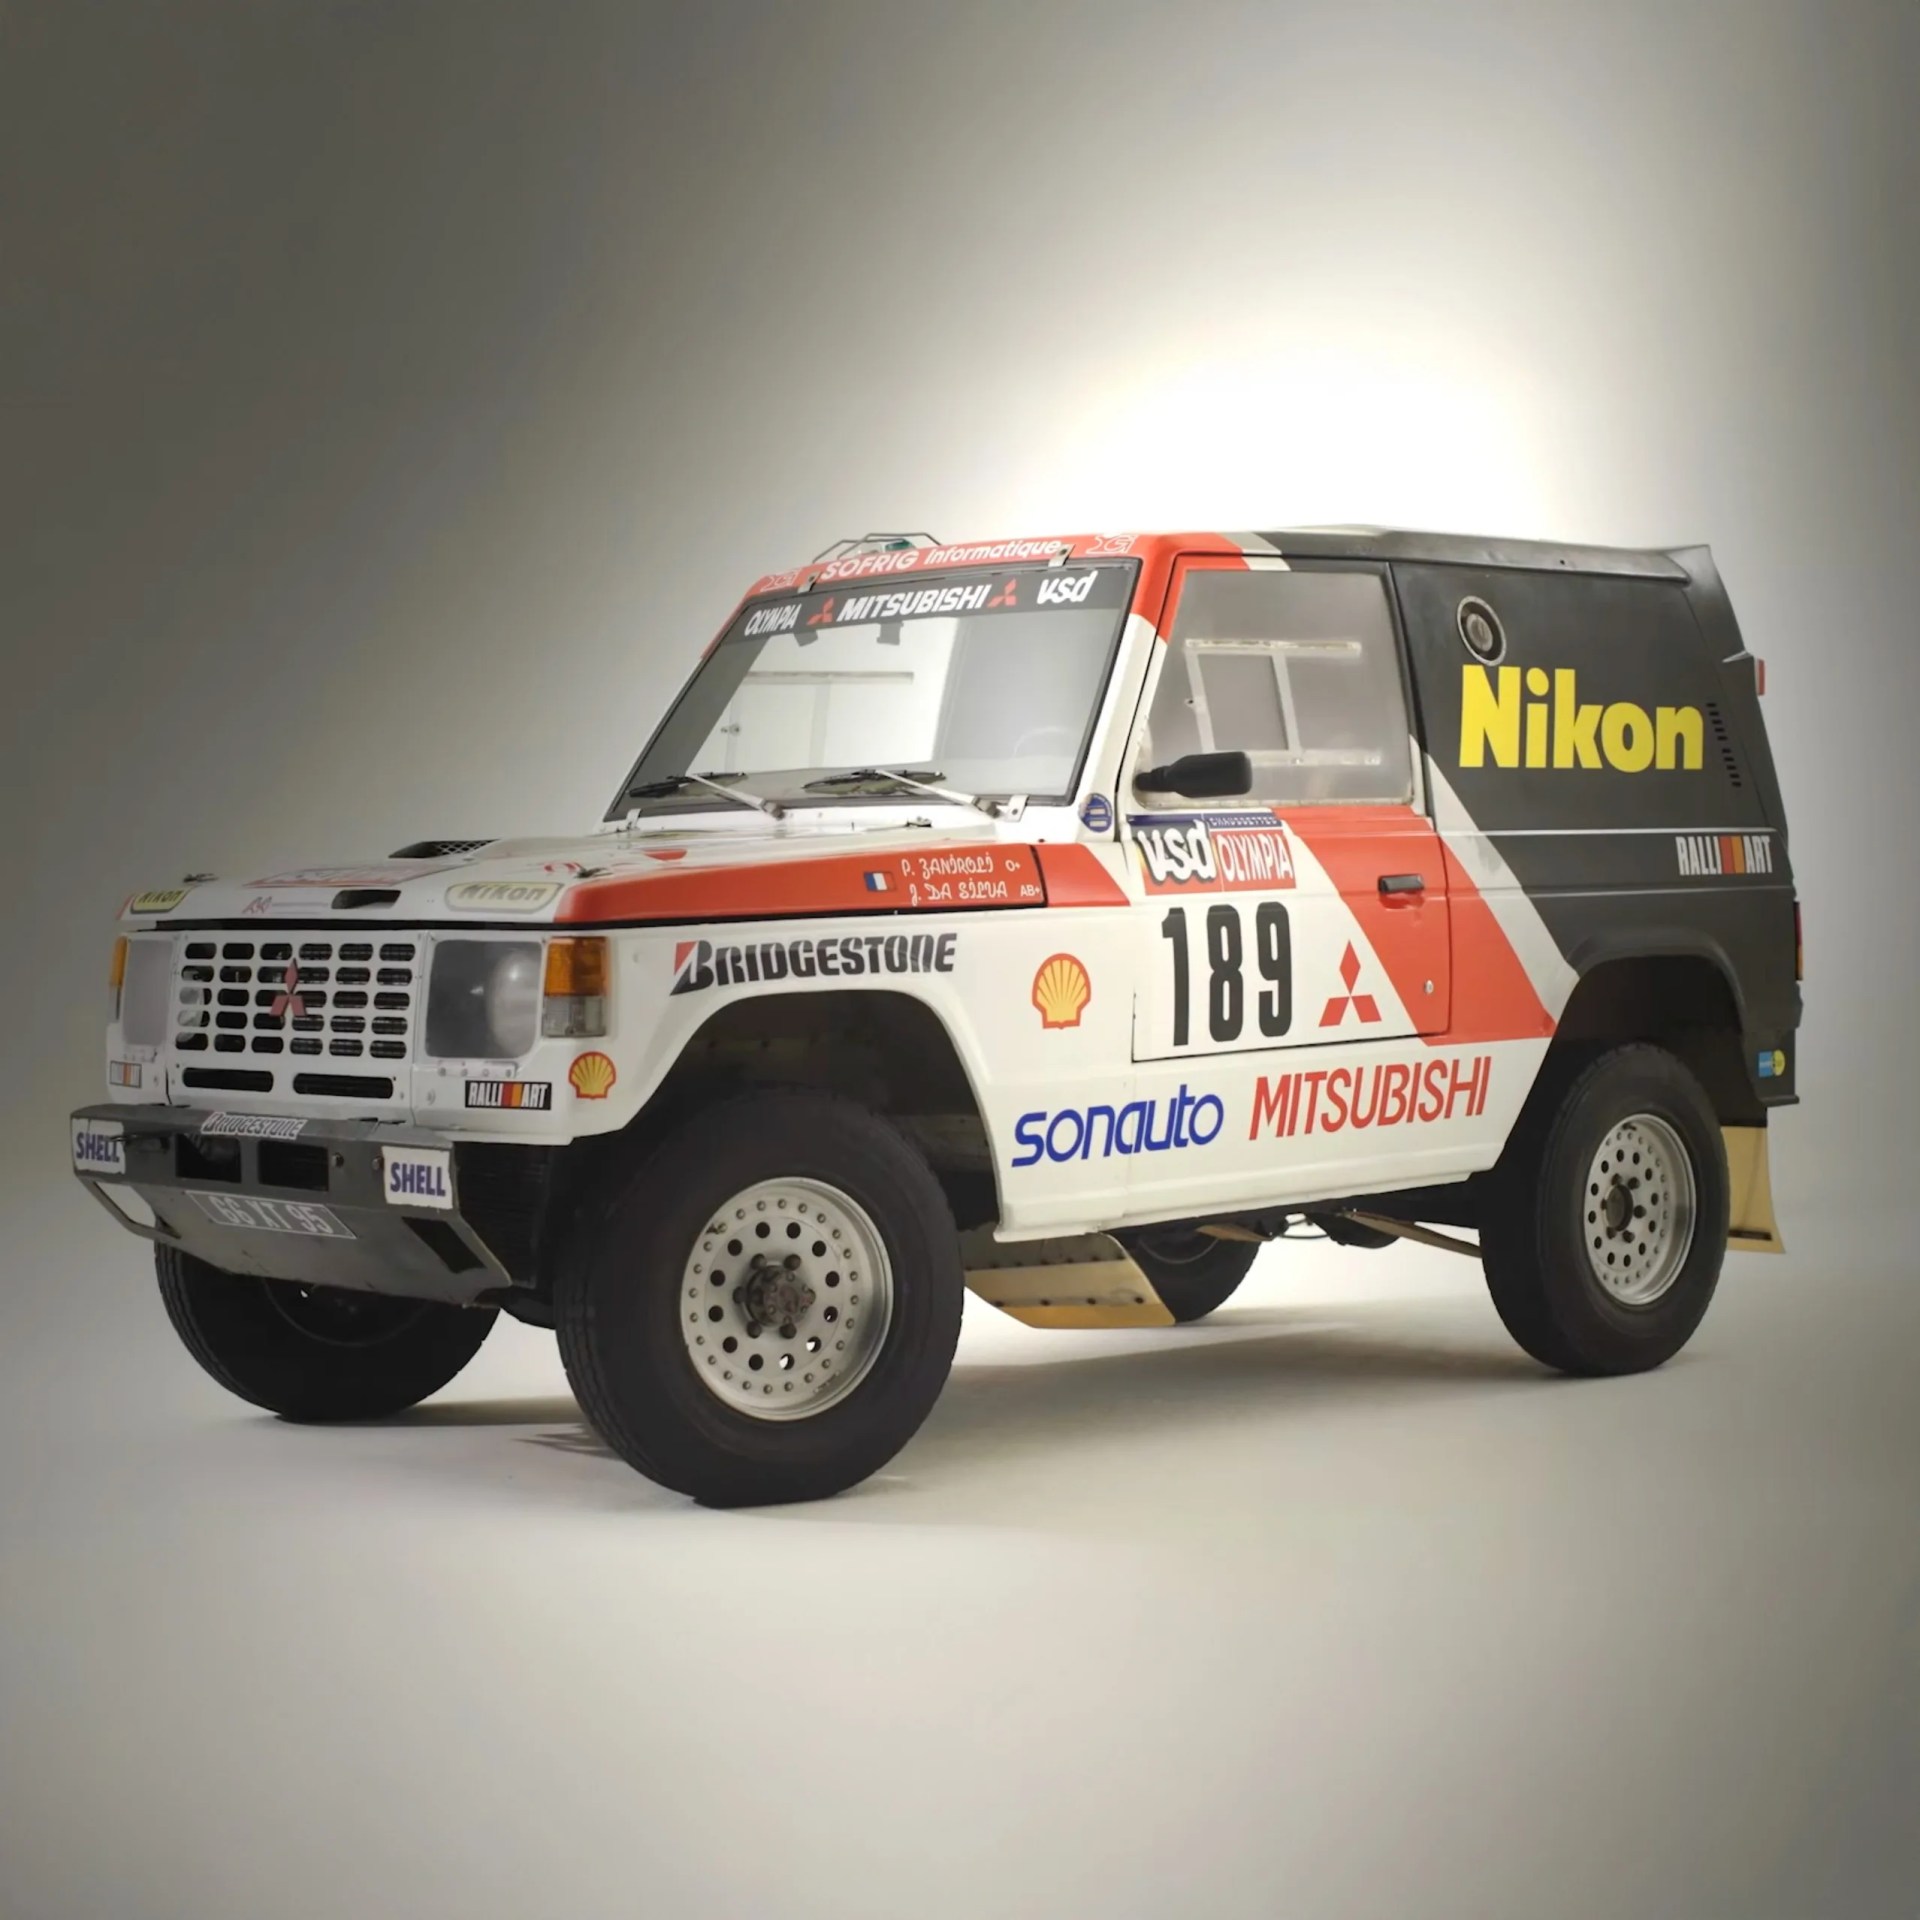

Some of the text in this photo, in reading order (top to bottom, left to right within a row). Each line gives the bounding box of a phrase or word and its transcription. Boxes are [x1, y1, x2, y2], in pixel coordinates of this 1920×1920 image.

[820, 551, 919, 580] SOFRIG
[924, 540, 1062, 564] Informatique
[836, 584, 993, 622] MITSUBISHI
[1036, 570, 1098, 605] vsd
[744, 603, 802, 636] OLYMPIA
[1458, 664, 1704, 773] Nikon
[1137, 819, 1217, 882] vsd
[1217, 833, 1294, 882] OLYMPIA
[924, 883, 952, 901] DA
[958, 877, 1008, 900] SILVA
[1020, 884, 1041, 898] AB+
[670, 932, 957, 996] BRIDGESTONE
[1162, 901, 1292, 1046] 189
[1249, 1055, 1492, 1141] MITSUBISHI
[1011, 1084, 1224, 1167] sonauto
[76, 1131, 120, 1163] SHELL
[390, 1162, 446, 1197] SHELL
[208, 1196, 256, 1226] 66
[285, 1204, 334, 1234] 95
